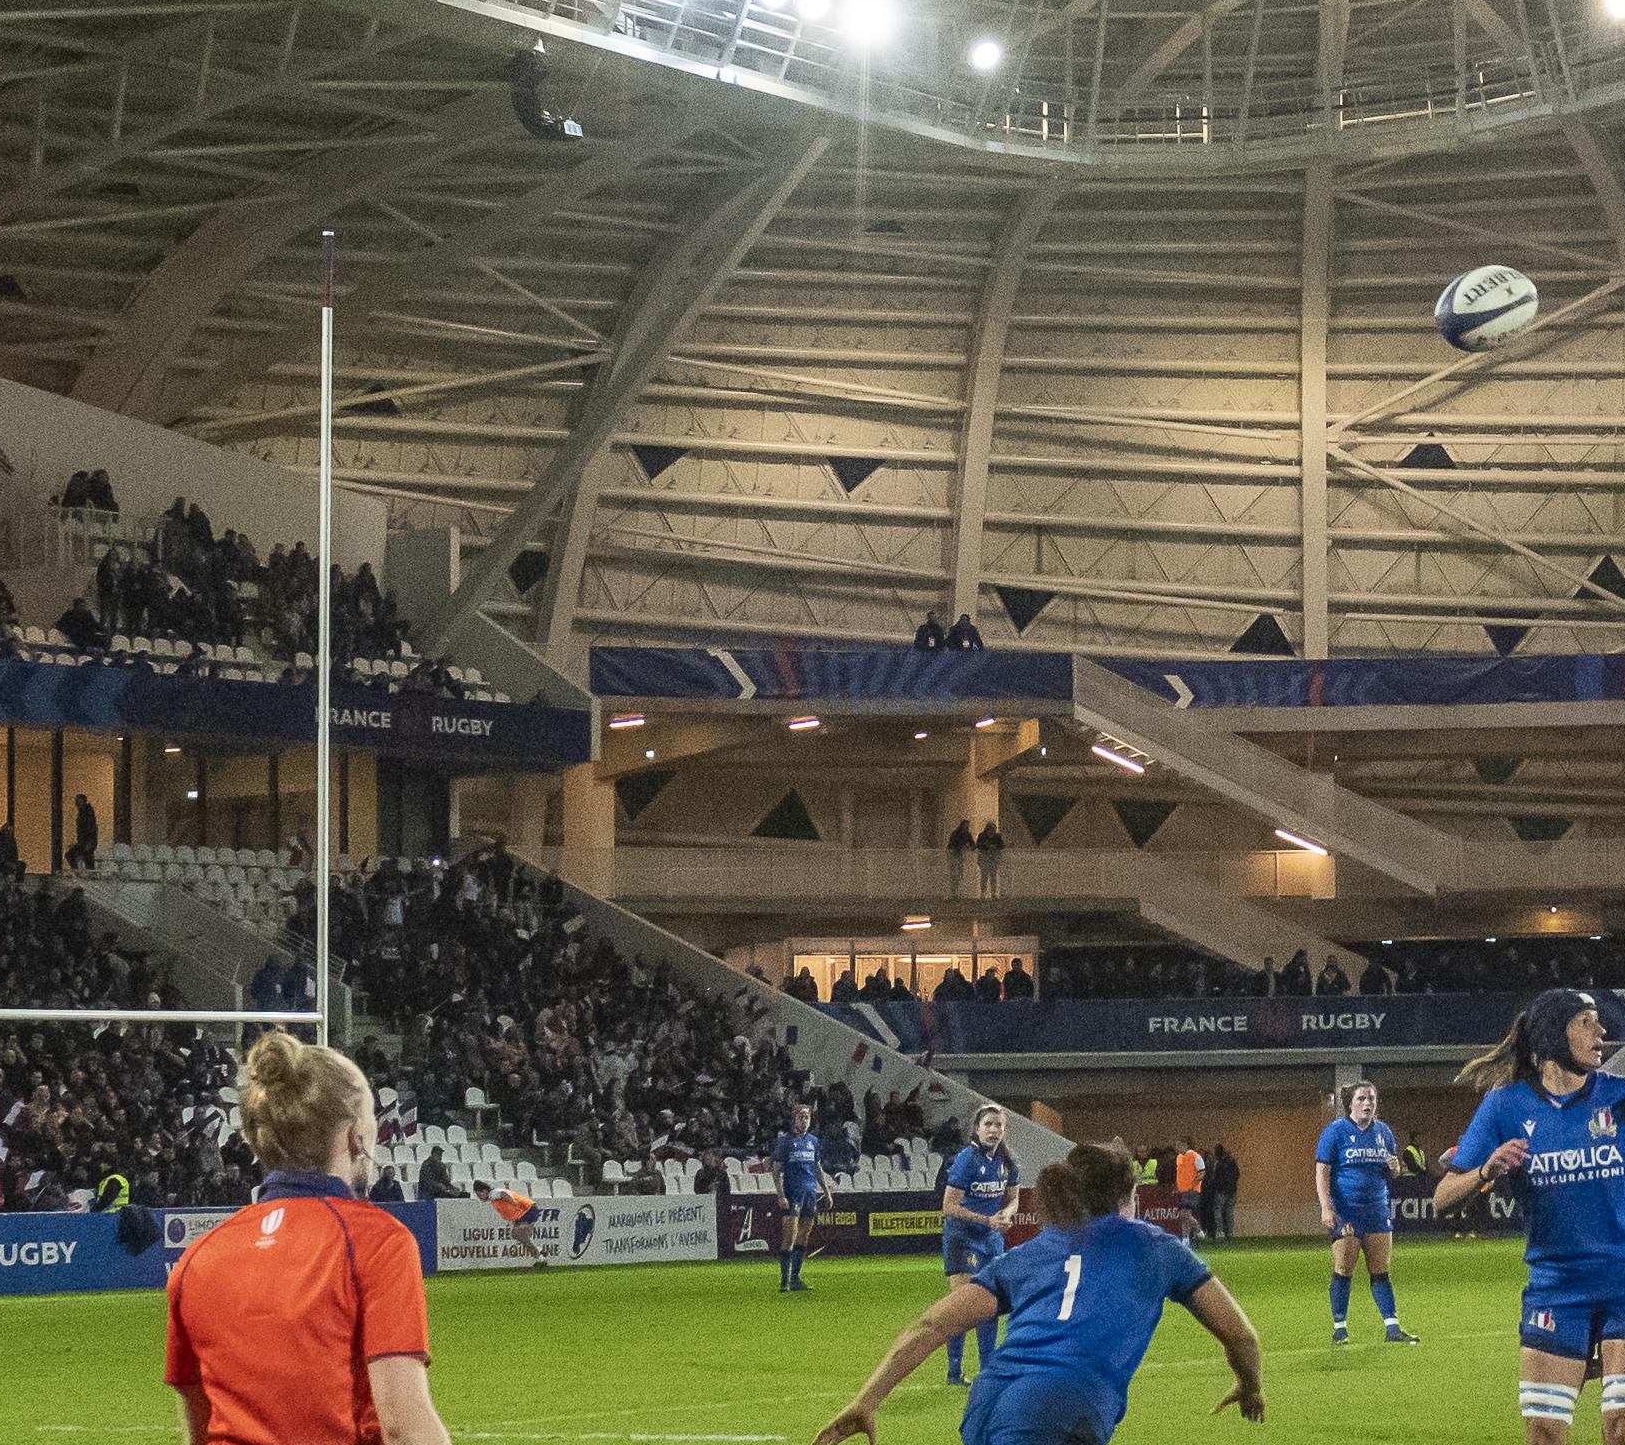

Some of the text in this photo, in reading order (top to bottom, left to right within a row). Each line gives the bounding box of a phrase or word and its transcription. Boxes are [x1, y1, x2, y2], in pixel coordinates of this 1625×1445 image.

[316, 708, 493, 736] RANCE RUGBY
[1148, 1013, 1386, 1033] FRANCE RUGBY
[1527, 1145, 1623, 1174] ATTOLICA
[1530, 1167, 1624, 1186] SSICURAZIONI
[1011, 1212, 1039, 1225] TRAD
[463, 1223, 559, 1241] LIGUE RÉNALE
[442, 1245, 498, 1259] NOUVELLE
[1056, 1255, 1081, 1321] 1
